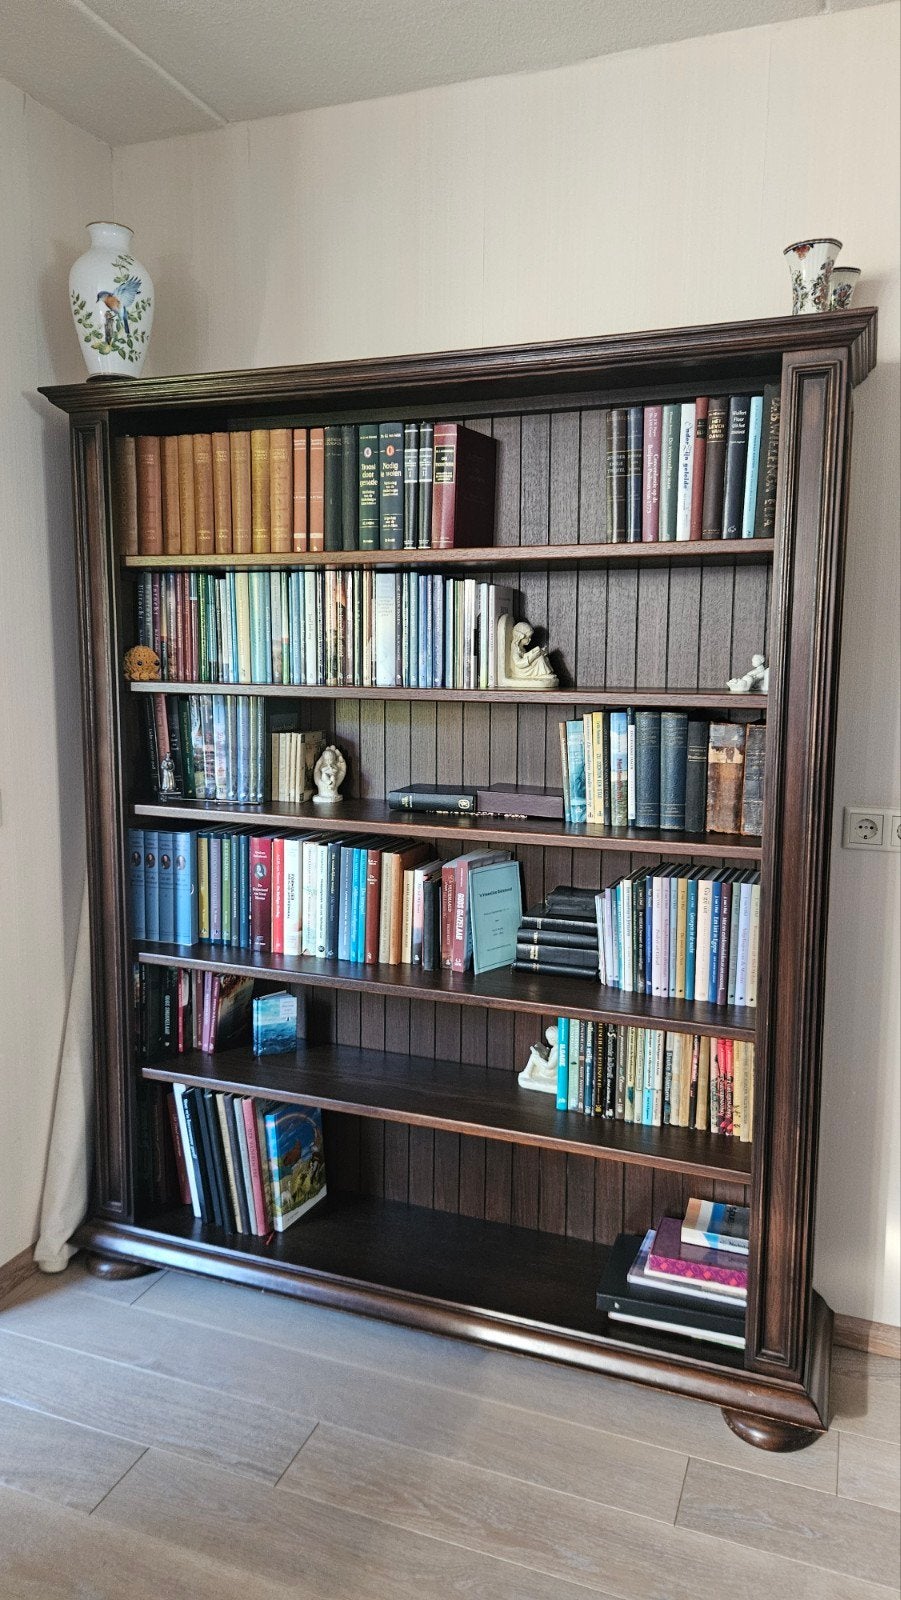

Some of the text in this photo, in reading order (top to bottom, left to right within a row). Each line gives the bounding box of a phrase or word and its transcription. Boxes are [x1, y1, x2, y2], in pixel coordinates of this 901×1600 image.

[382, 462, 400, 471] Nodig
[455, 892, 465, 941] GODS GIJZELAAR
